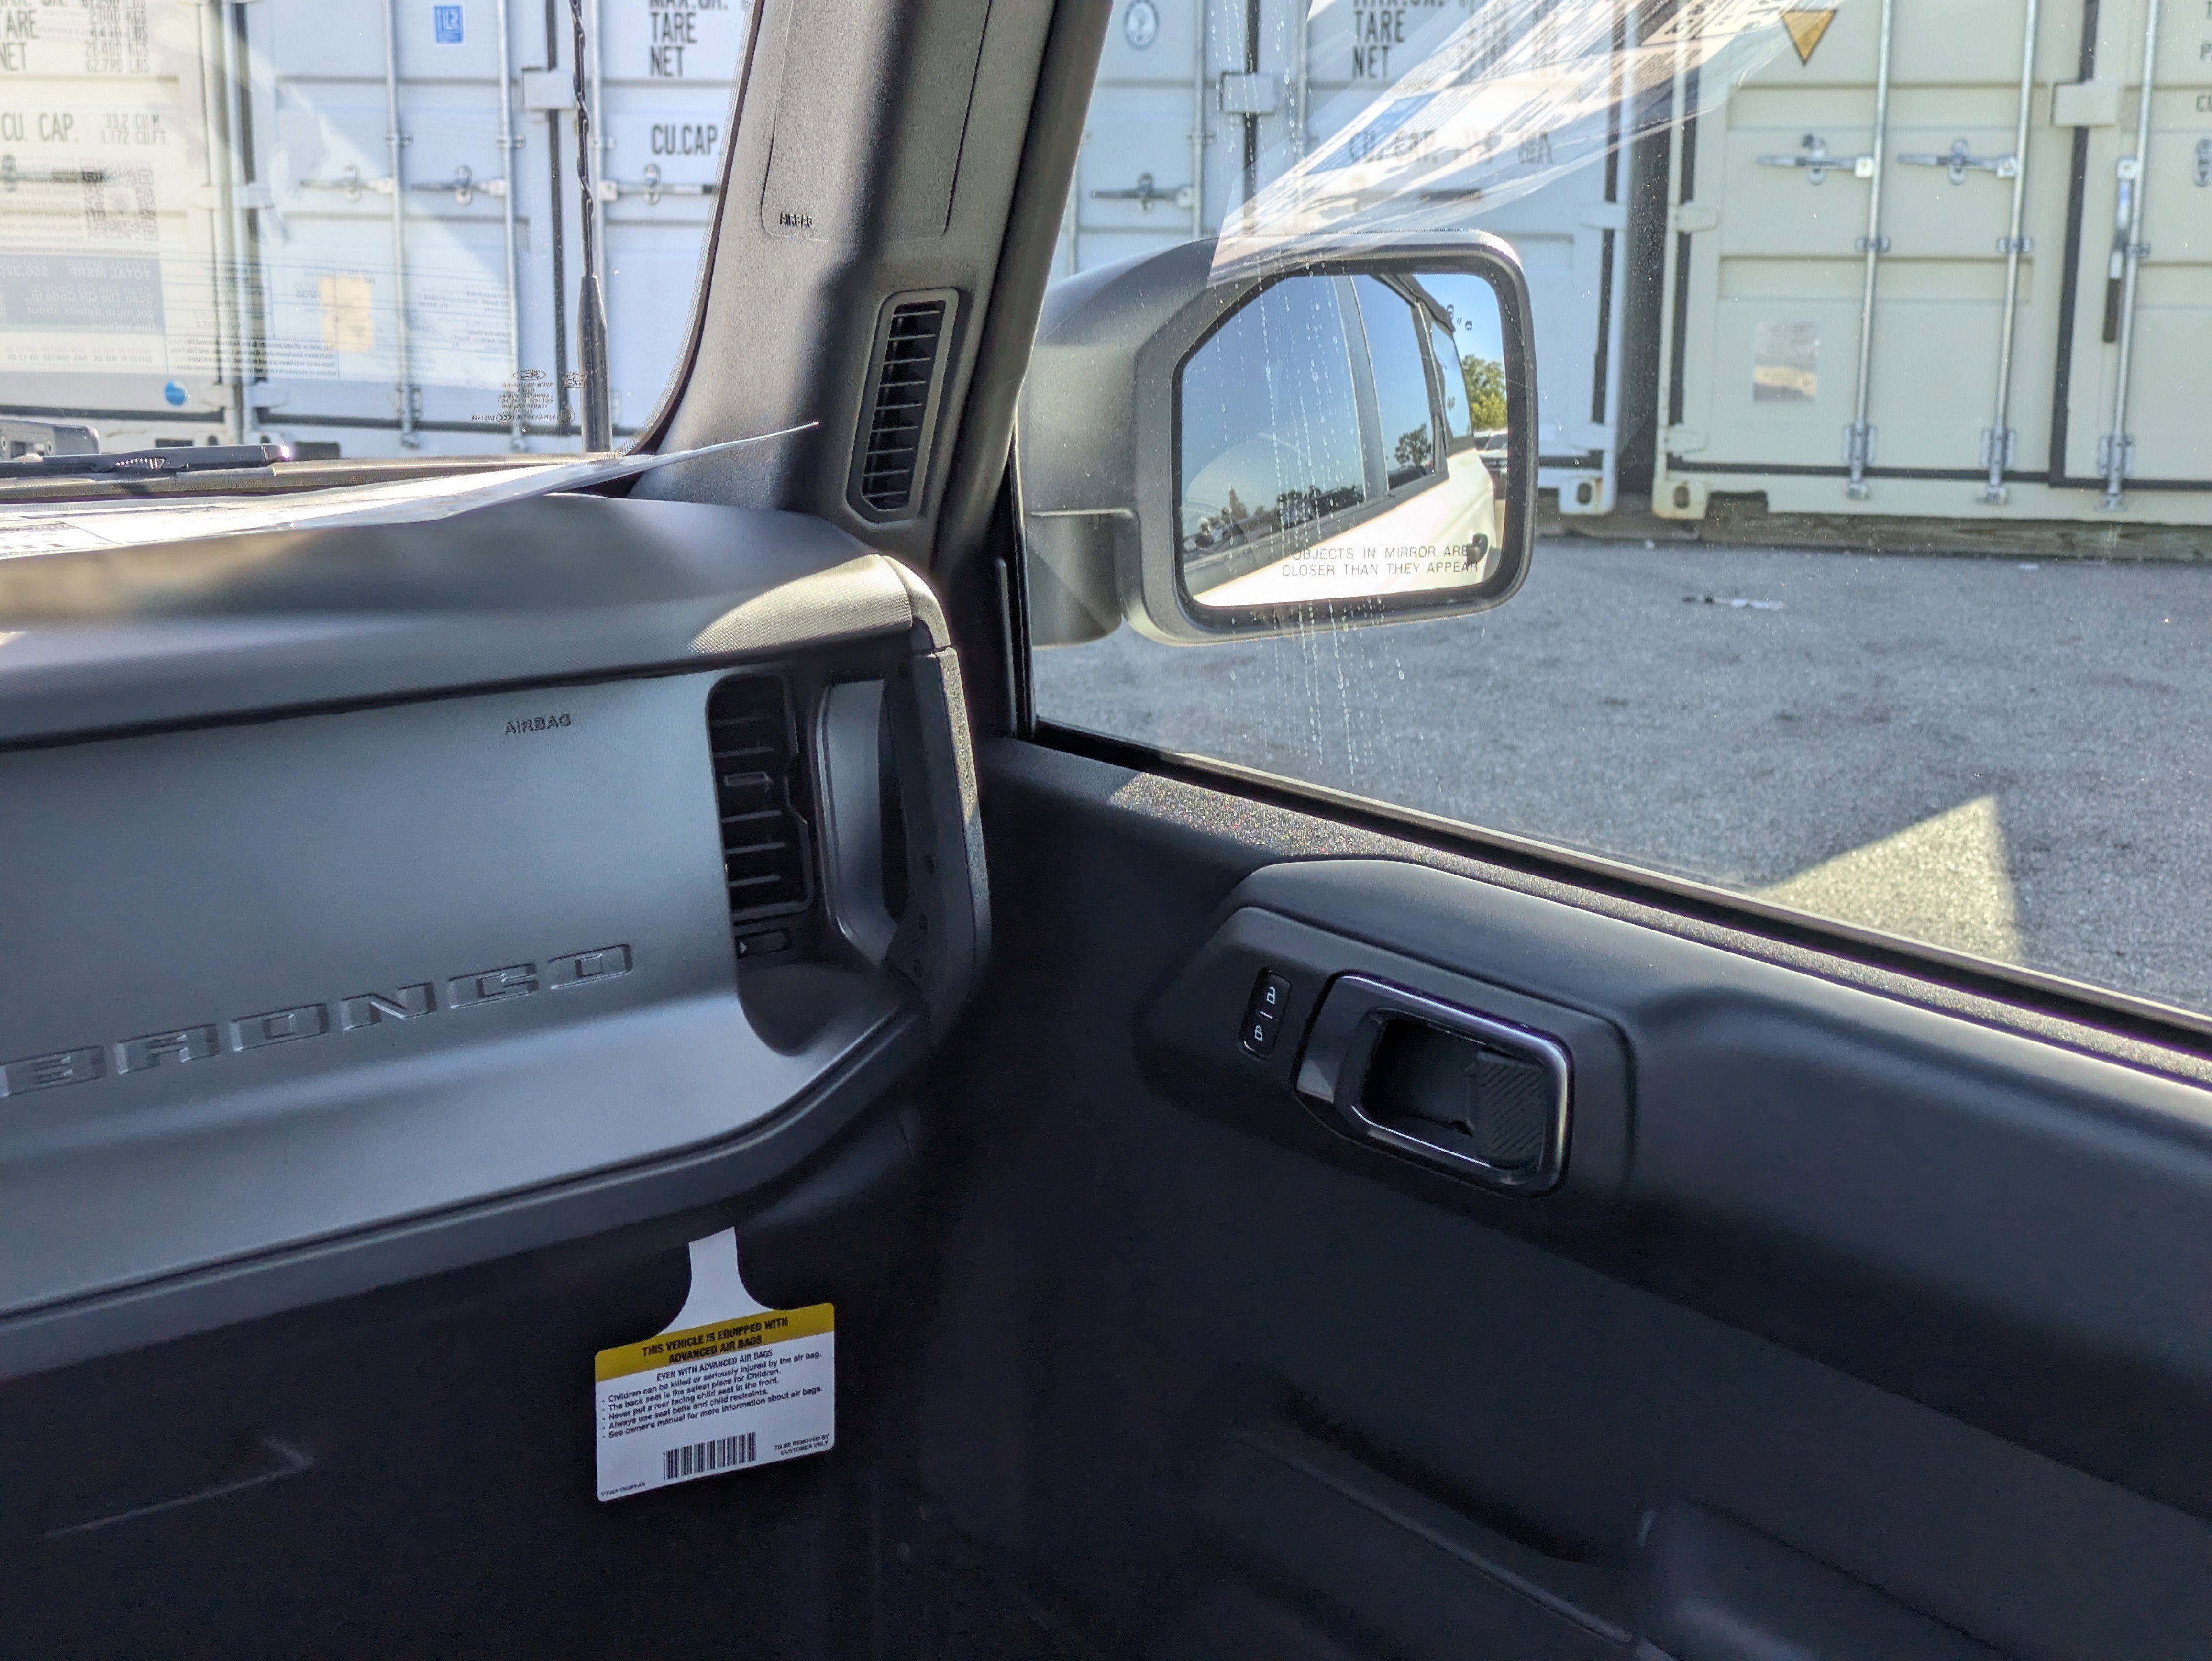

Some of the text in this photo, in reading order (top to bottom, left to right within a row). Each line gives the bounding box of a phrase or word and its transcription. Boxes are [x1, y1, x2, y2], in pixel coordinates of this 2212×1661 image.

[0, 9, 40, 39] ARE
[650, 12, 698, 44] TARE
[1354, 9, 1405, 43] TARE
[650, 46, 685, 77] NET
[1352, 45, 1389, 78] NET
[1282, 561, 1478, 576] CLOSER THAN THEY APPEAR
[1292, 545, 1469, 560] OBJECTS IN MIRROR ARE
[504, 713, 571, 735] AIRBAG
[0, 944, 633, 1097] BRONCO
[642, 1317, 788, 1357] THIS VEHICLE IS EQUIPPED WITH
[669, 1335, 763, 1364] ADVANCED AIR BAGS
[608, 1390, 641, 1403] Children
[671, 1378, 691, 1388] killed
[703, 1368, 738, 1381] seriously
[741, 1361, 766, 1373] injured
[768, 1360, 778, 1368] by
[657, 1349, 773, 1382] EVEN WITH ADVANCED AIR BAGS
[608, 1403, 623, 1411] The
[625, 1398, 644, 1407] back
[646, 1393, 661, 1403] seat
[686, 1383, 710, 1394] safest
[712, 1379, 732, 1390] place
[746, 1367, 781, 1380] Children.
[608, 1410, 631, 1421] Never
[633, 1406, 646, 1416] put
[672, 1395, 696, 1406] facing
[697, 1390, 716, 1400] child
[718, 1386, 734, 1395] seat
[759, 1377, 779, 1386] front.
[608, 1418, 636, 1429] Always
[654, 1409, 671, 1418] seat
[673, 1406, 691, 1414] belts
[693, 1401, 708, 1409] and
[709, 1396, 728, 1406] child
[730, 1388, 768, 1402] restraints.
[625, 1422, 655, 1434] owner's
[657, 1414, 685, 1427] manual
[700, 1407, 719, 1417] more
[721, 1398, 765, 1412] information
[767, 1392, 789, 1403] about
[790, 1389, 801, 1398] air
[803, 1386, 823, 1395] bags.
[781, 1444, 812, 1455] CUSTOMER
